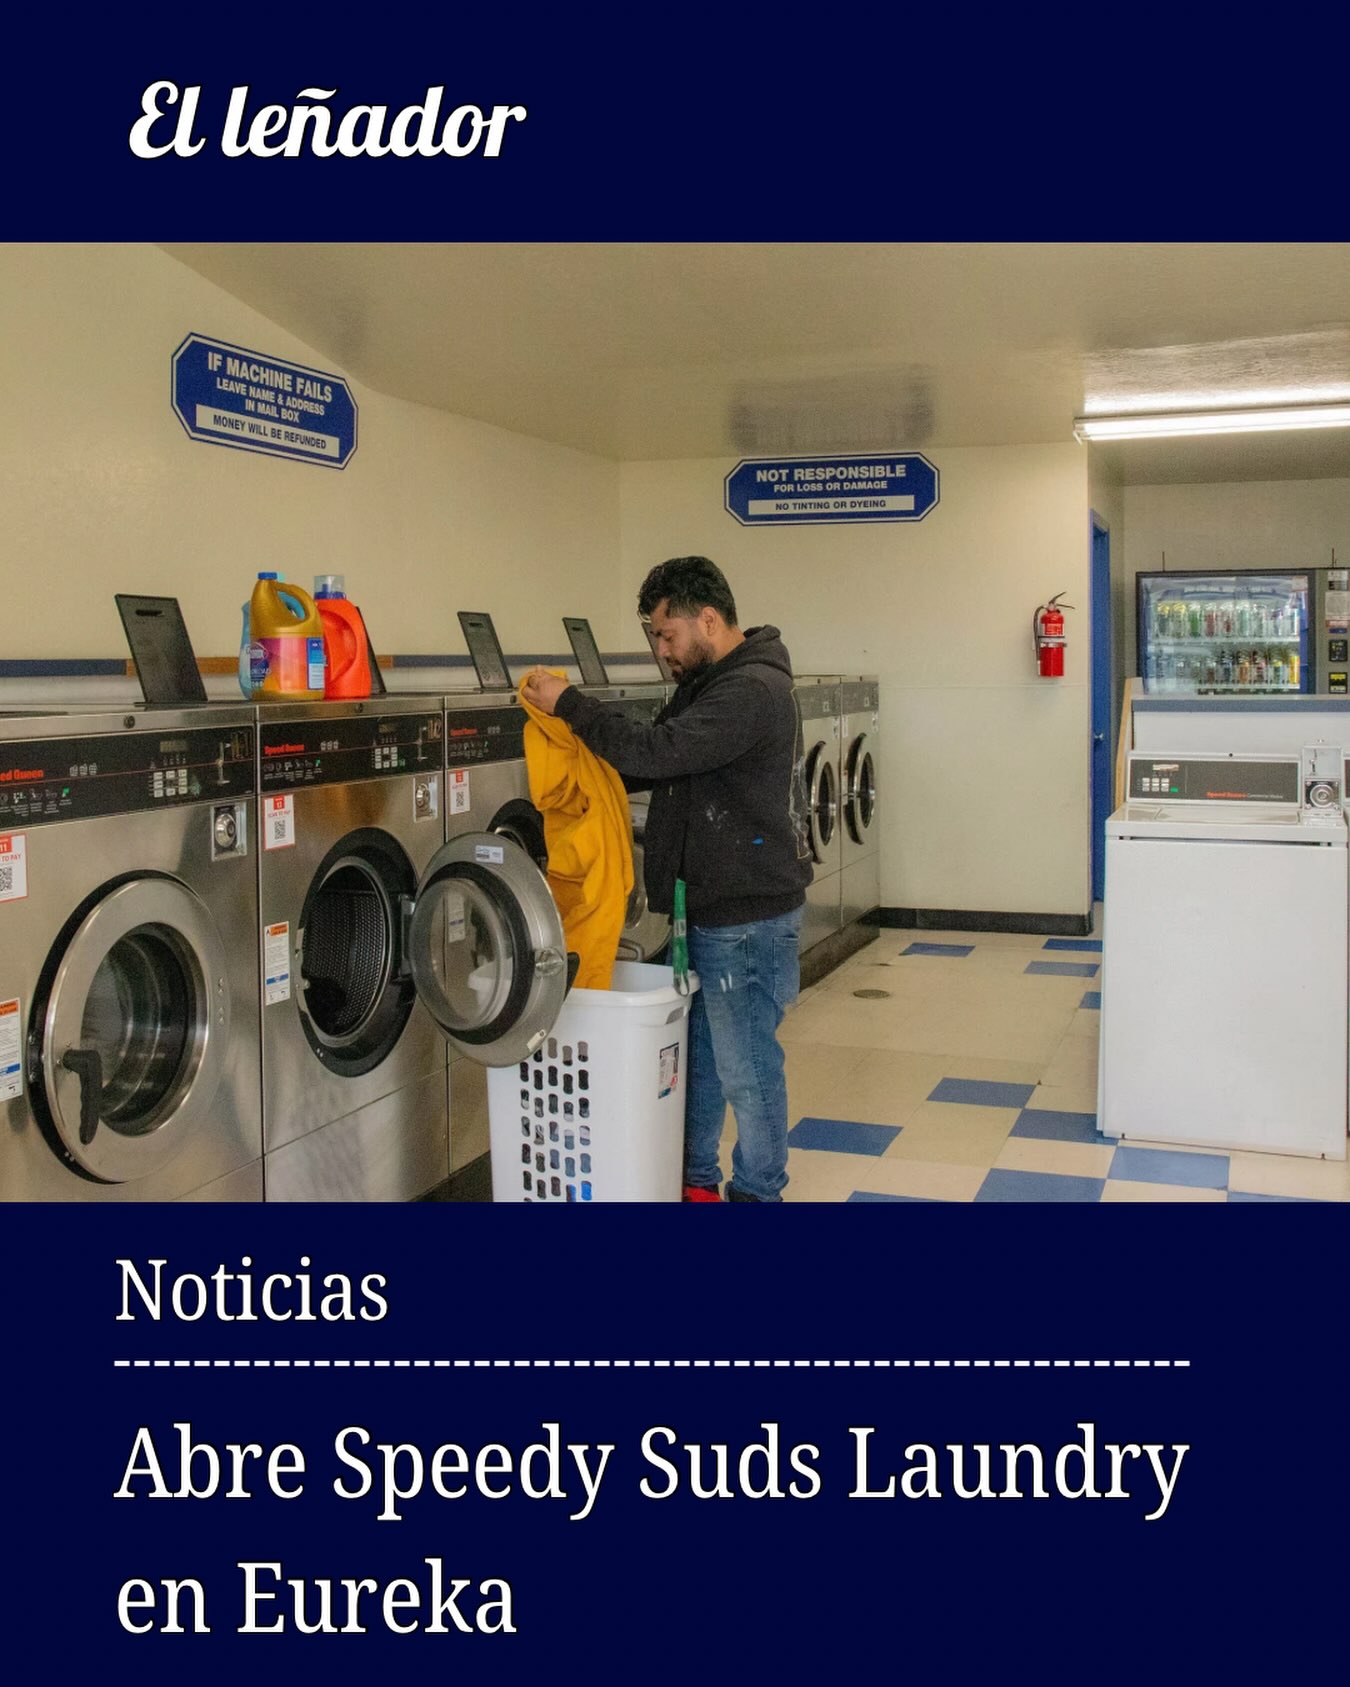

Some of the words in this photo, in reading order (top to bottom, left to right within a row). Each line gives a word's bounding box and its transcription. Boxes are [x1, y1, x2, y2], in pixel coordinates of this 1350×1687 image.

[207, 351, 223, 372] IF
[226, 356, 293, 391] MACHINE
[296, 377, 333, 404] FAILS
[216, 376, 247, 396] LEAVE
[249, 385, 276, 404] NAME
[277, 393, 284, 404] &
[286, 396, 325, 416] ADDRESS
[245, 398, 256, 412] IN
[257, 401, 279, 418] MAIL
[281, 408, 301, 424] BOX
[213, 414, 246, 432] MONEY
[248, 422, 268, 437] WILL
[270, 428, 282, 440] BE
[284, 431, 327, 450] REFUNDED
[756, 468, 789, 483] NOT
[793, 464, 907, 481] RESPONSIBLE
[773, 483, 795, 494] FOR
[797, 482, 823, 493] LOSS
[825, 481, 841, 491] OR
[843, 480, 888, 491] DAMAGE
[775, 502, 790, 512] NO
[792, 501, 831, 511] TINTING
[833, 500, 848, 510] OR
[850, 499, 887, 509] DYEING
[13, 768, 44, 780] Queen
